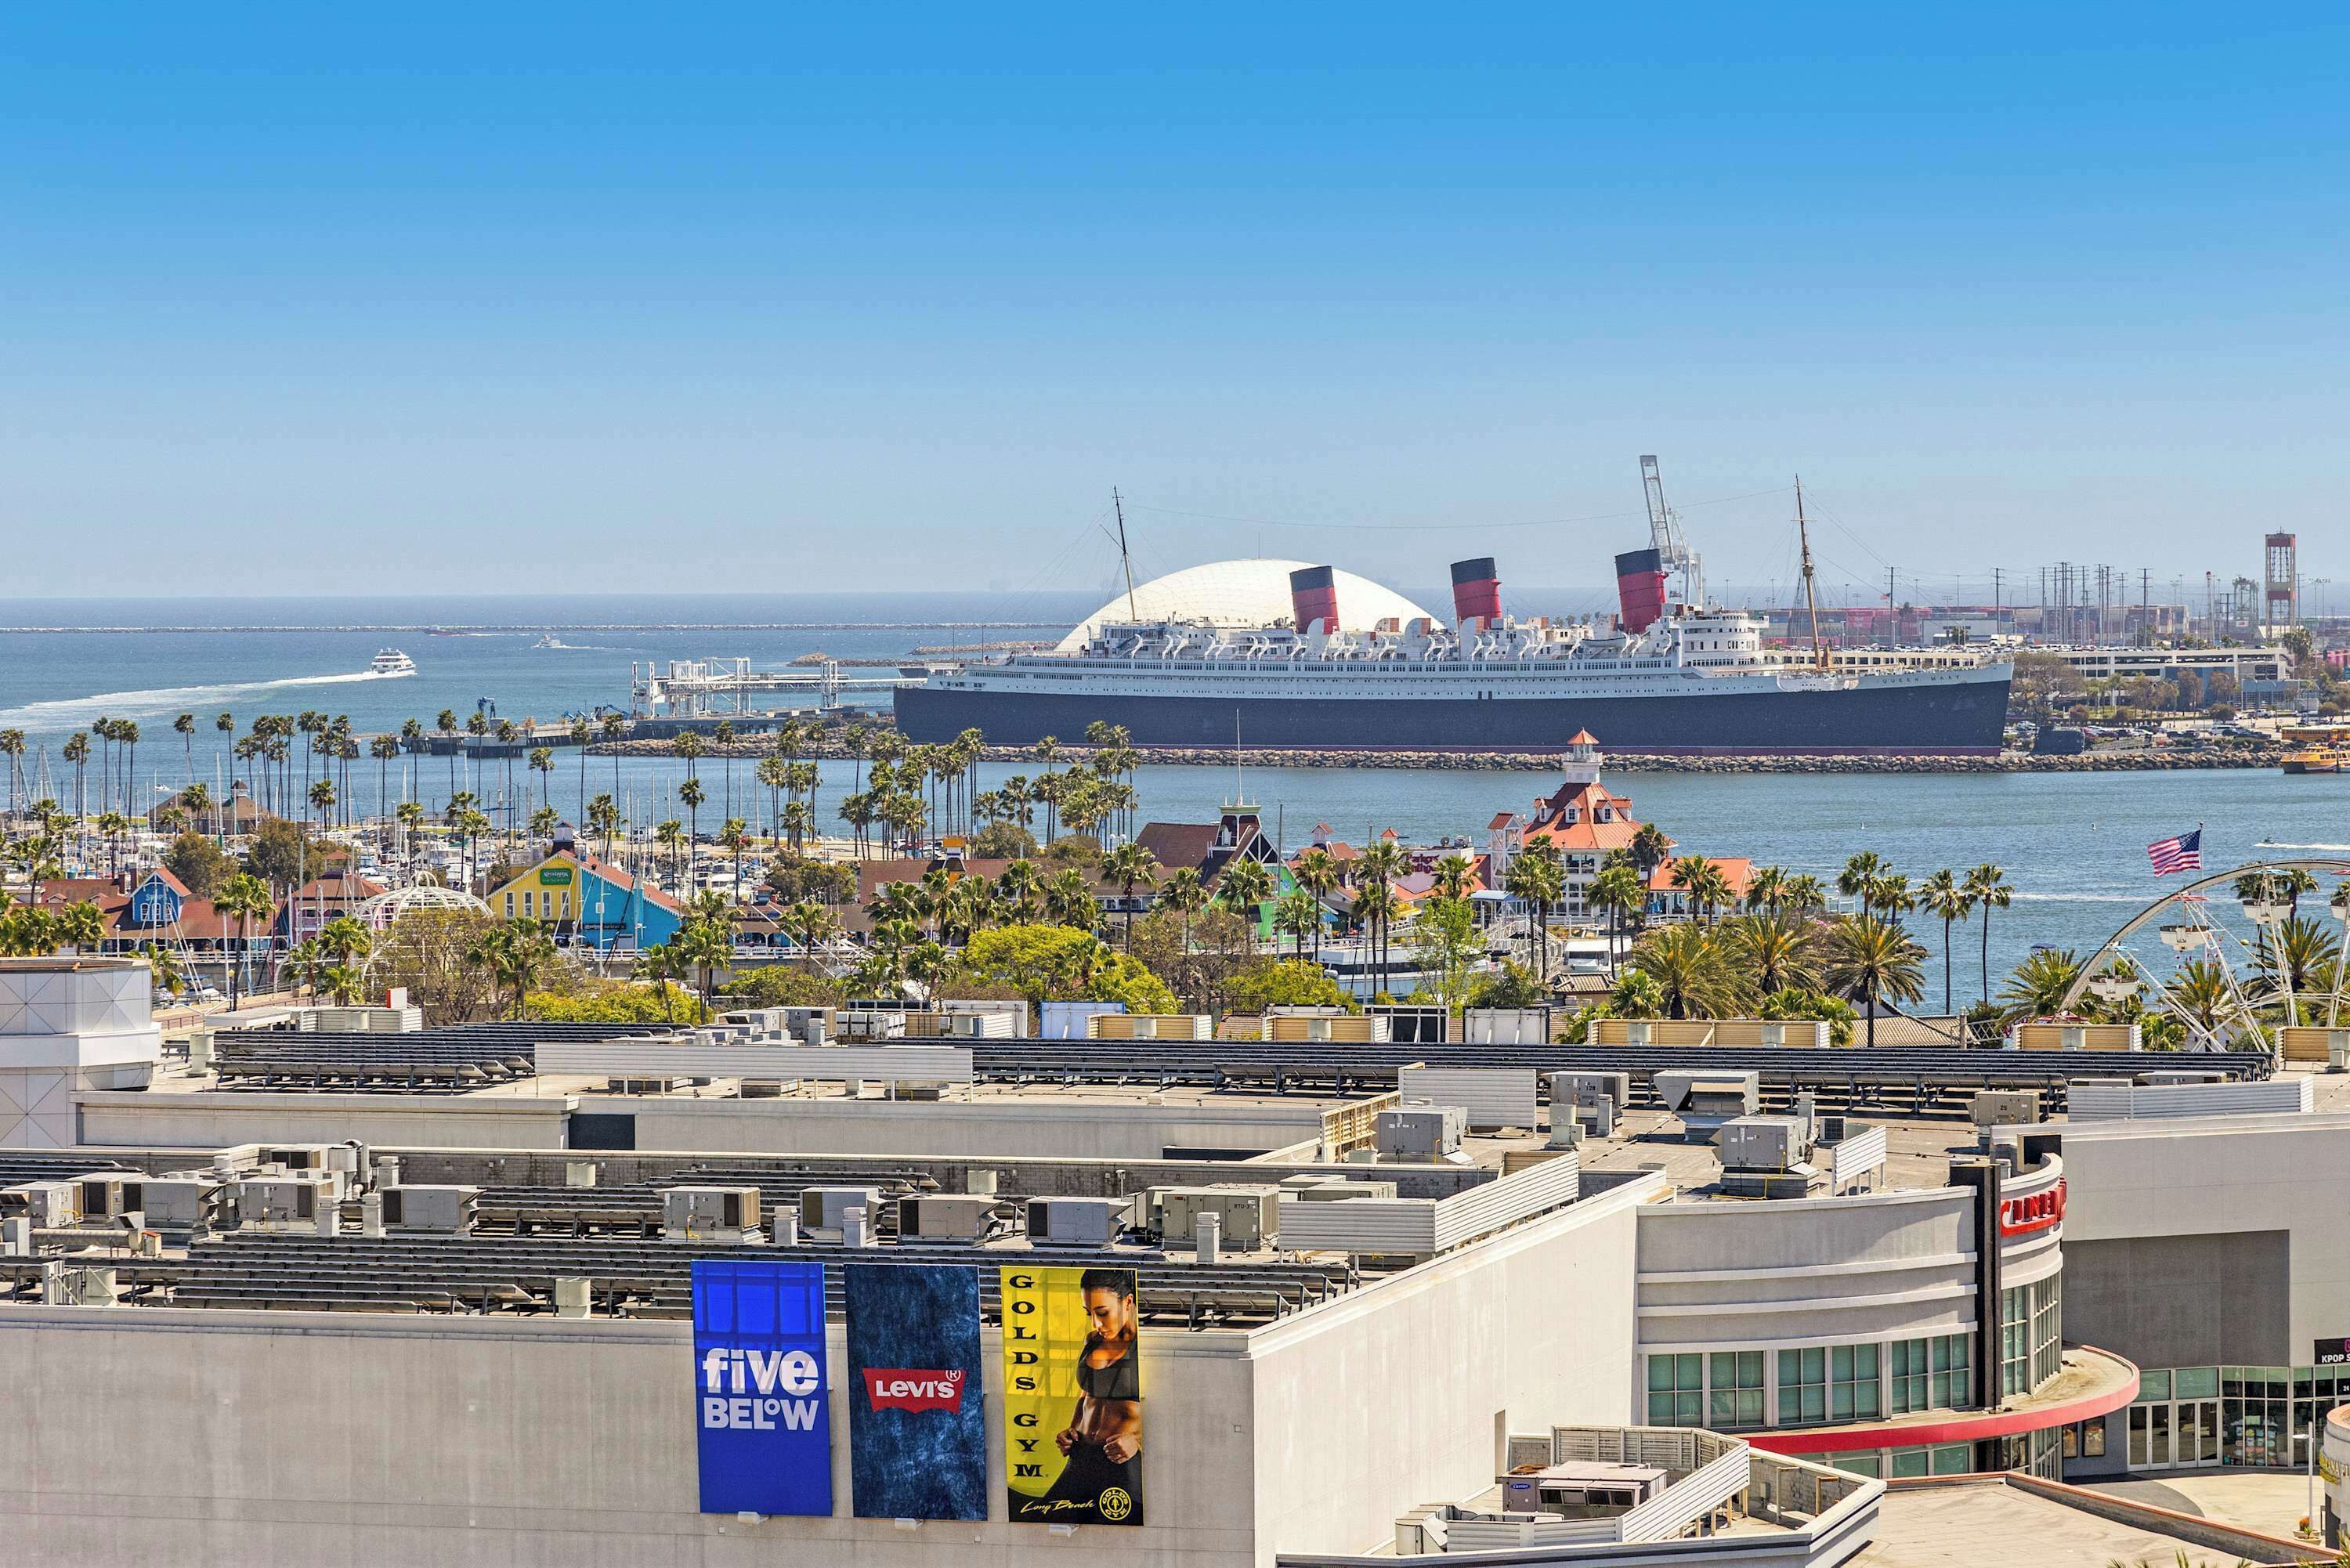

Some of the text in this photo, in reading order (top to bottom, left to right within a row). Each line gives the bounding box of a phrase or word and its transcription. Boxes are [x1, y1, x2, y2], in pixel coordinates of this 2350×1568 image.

[702, 1348, 819, 1396] five
[2321, 1353, 2345, 1364] KPOP
[703, 1396, 819, 1431] BELOW
[1014, 1413, 1043, 1478] GYM
[1020, 1499, 1095, 1515] Long Beach
